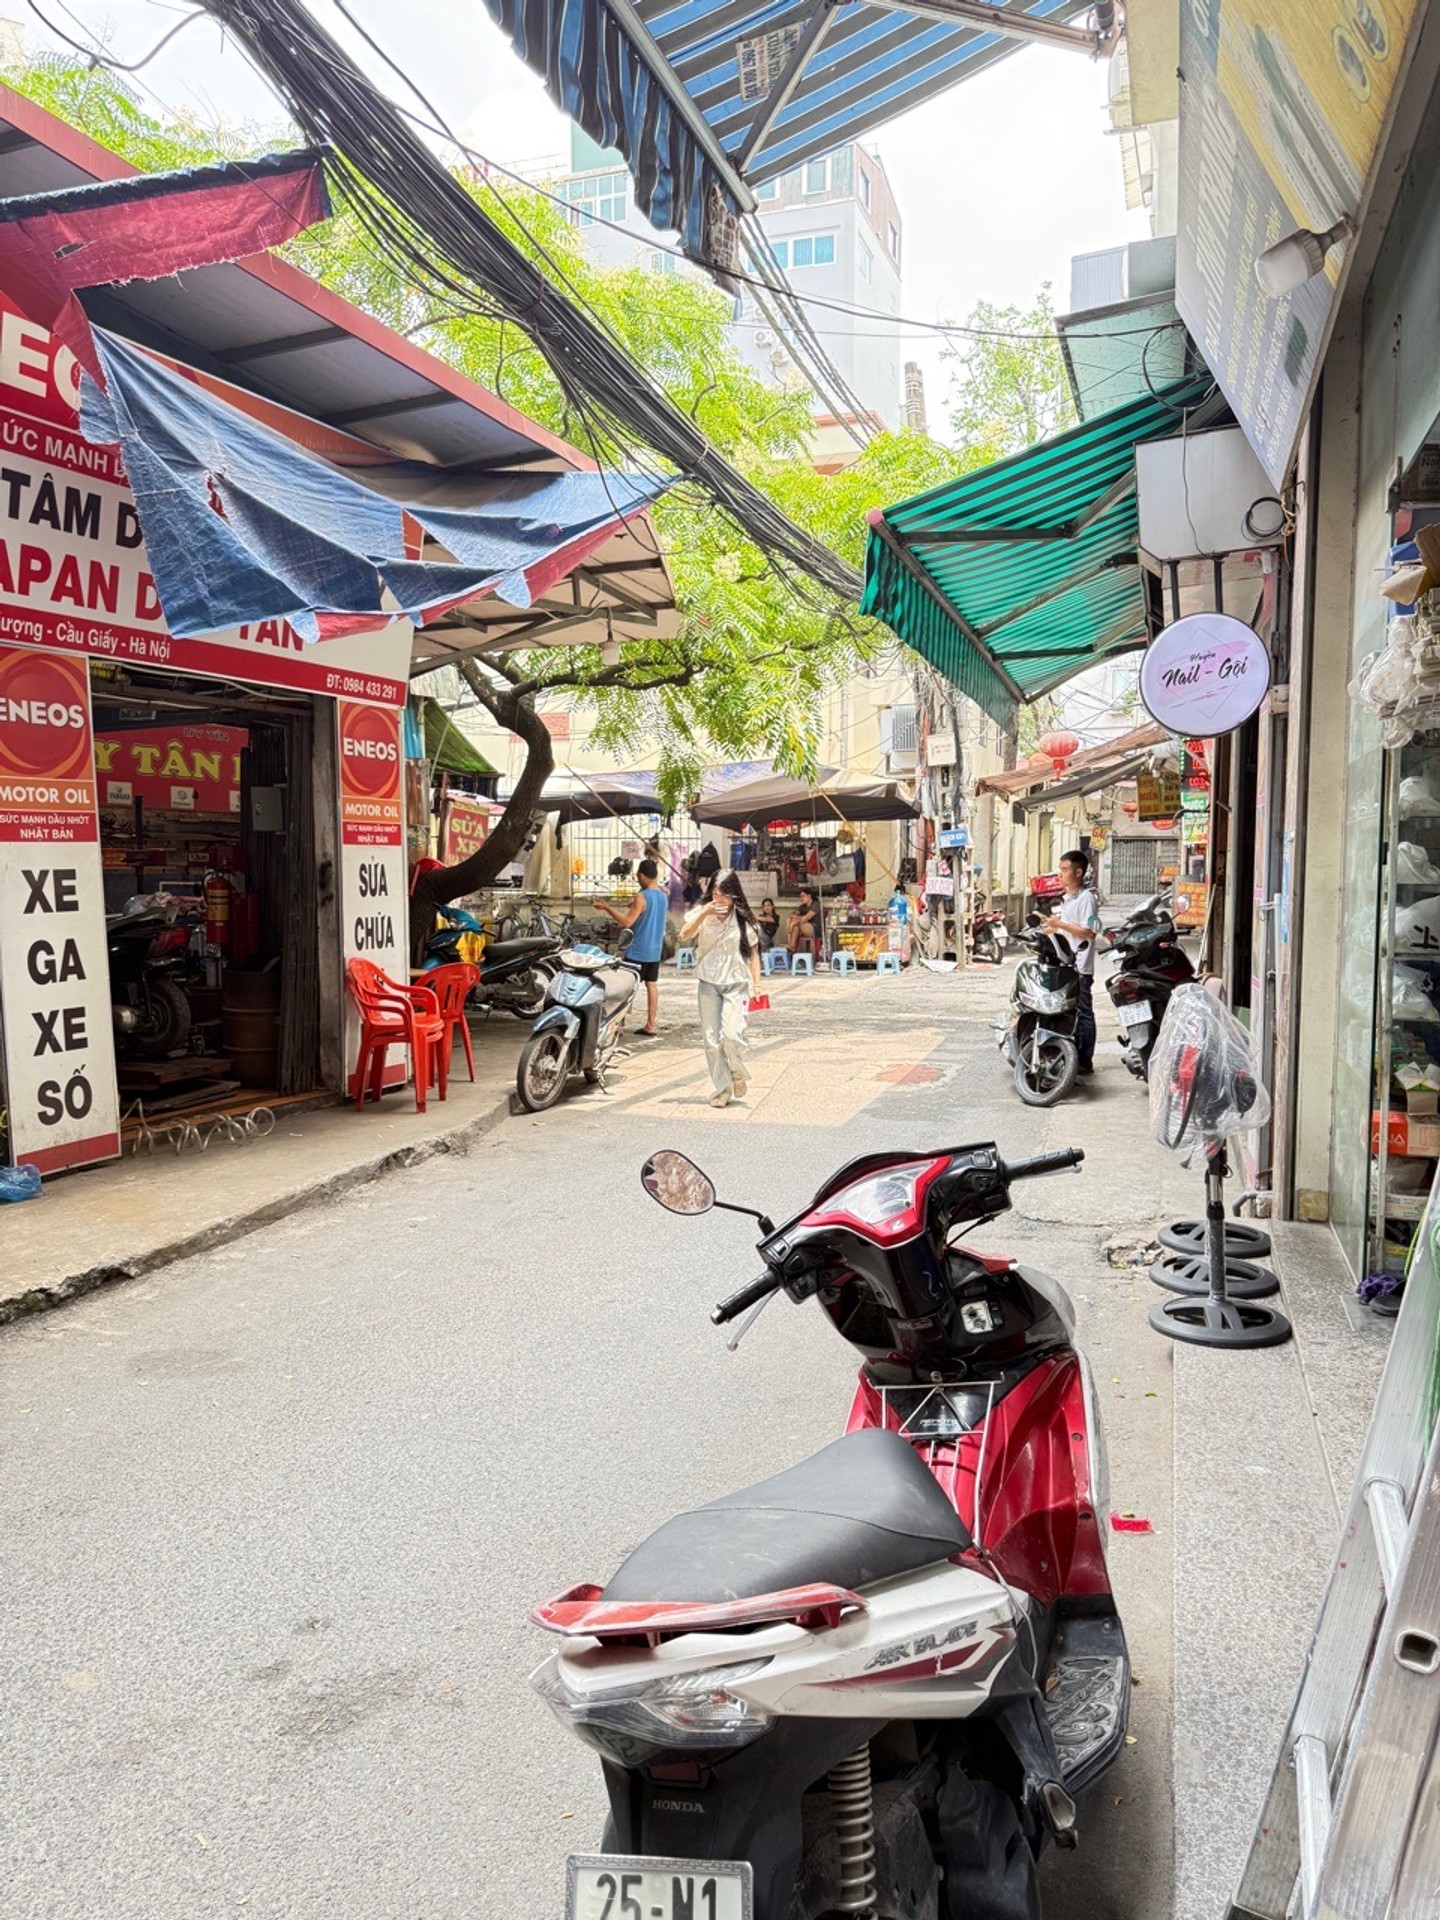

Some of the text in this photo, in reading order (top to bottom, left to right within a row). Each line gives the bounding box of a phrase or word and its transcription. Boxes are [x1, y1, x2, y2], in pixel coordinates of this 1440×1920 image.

[2, 418, 38, 451] ỨC
[45, 435, 108, 474] MẠNH
[2, 466, 101, 540] TÂM
[1, 616, 43, 642] ượng
[56, 620, 83, 645] Cầu
[88, 627, 118, 654] Giấy
[129, 636, 146, 656] Hà
[150, 639, 171, 662] Nội
[326, 673, 397, 700] ĐT: 0984 433 291
[1162, 663, 1201, 689] Nail
[1218, 656, 1248, 680] Gội
[131, 738, 222, 782] TÂN
[343, 737, 398, 762] ENEOS
[0, 785, 91, 804] MOTOR OIL
[345, 803, 399, 818] MOTOR OIL
[0, 812, 20, 824] SỨC
[21, 814, 47, 826] MẠNH
[48, 813, 66, 825] DẦU
[20, 826, 50, 841] NHẬT
[21, 869, 79, 914] XE
[358, 856, 388, 898] SỬA
[27, 938, 86, 985] GA
[32, 1006, 88, 1057] XE
[38, 1064, 92, 1126] SỐ
[653, 1800, 705, 1814] HONDA
[597, 1873, 717, 1920] 25-N1
